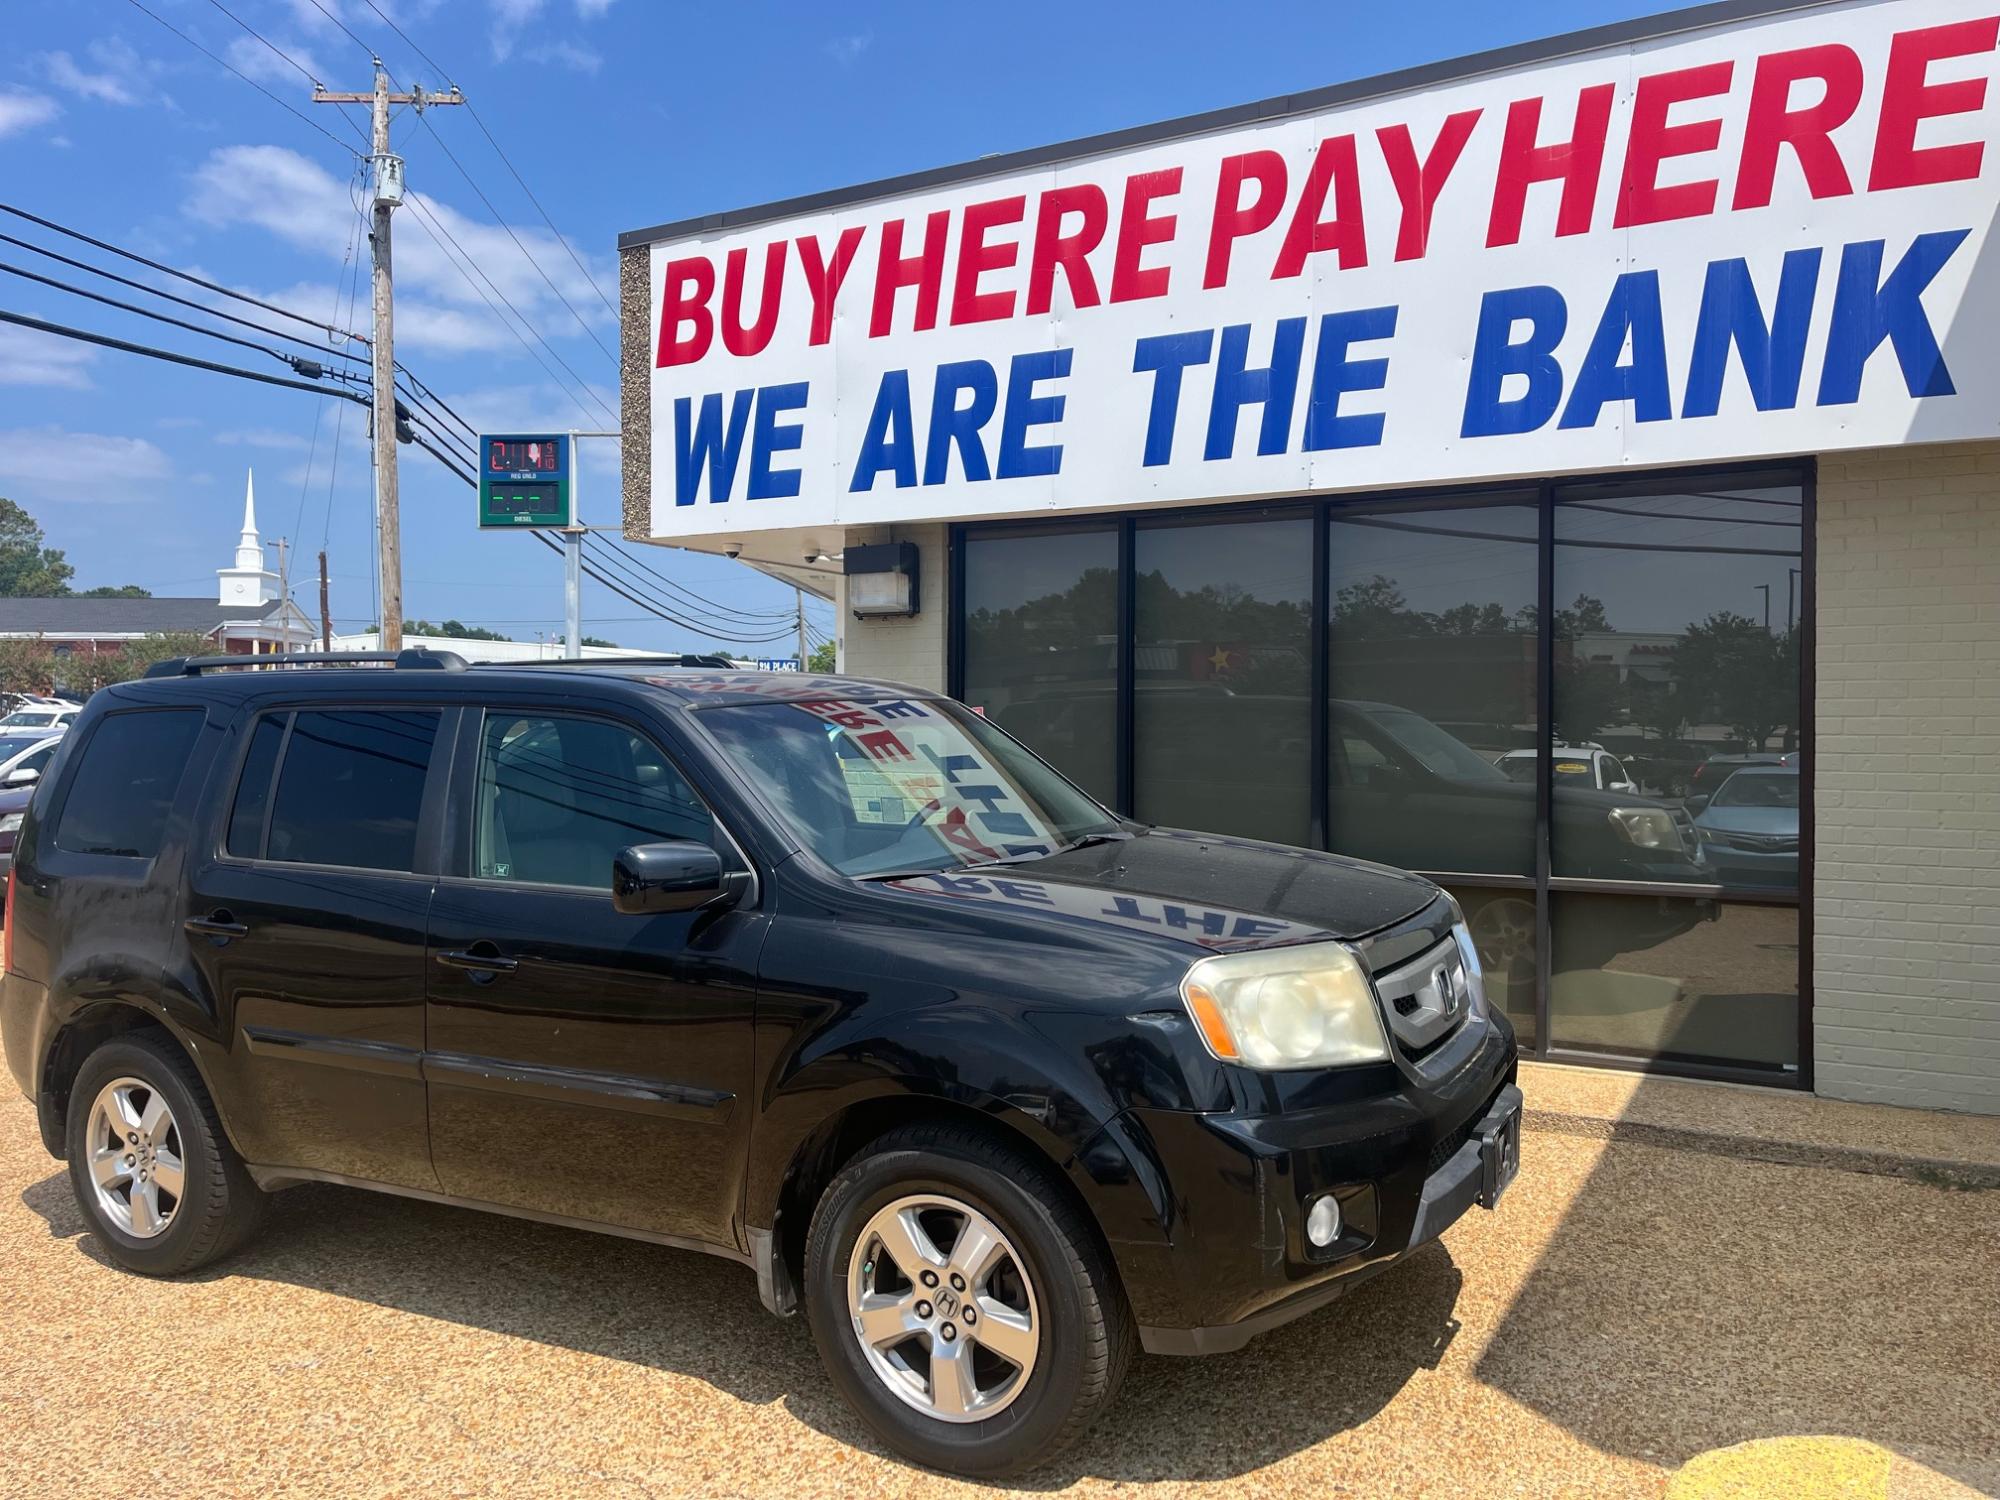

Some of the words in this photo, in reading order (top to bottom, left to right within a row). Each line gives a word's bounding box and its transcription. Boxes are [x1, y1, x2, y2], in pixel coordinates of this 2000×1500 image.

[656, 226, 867, 369] BUY
[868, 167, 1184, 339] HERE
[1203, 108, 1484, 290] PAY
[1485, 16, 2000, 249] HERE
[674, 381, 810, 507] WE
[849, 347, 1074, 493] ARE
[1132, 305, 1399, 468] THE
[1460, 228, 1972, 439] BANK
[772, 661, 798, 672] PLACE
